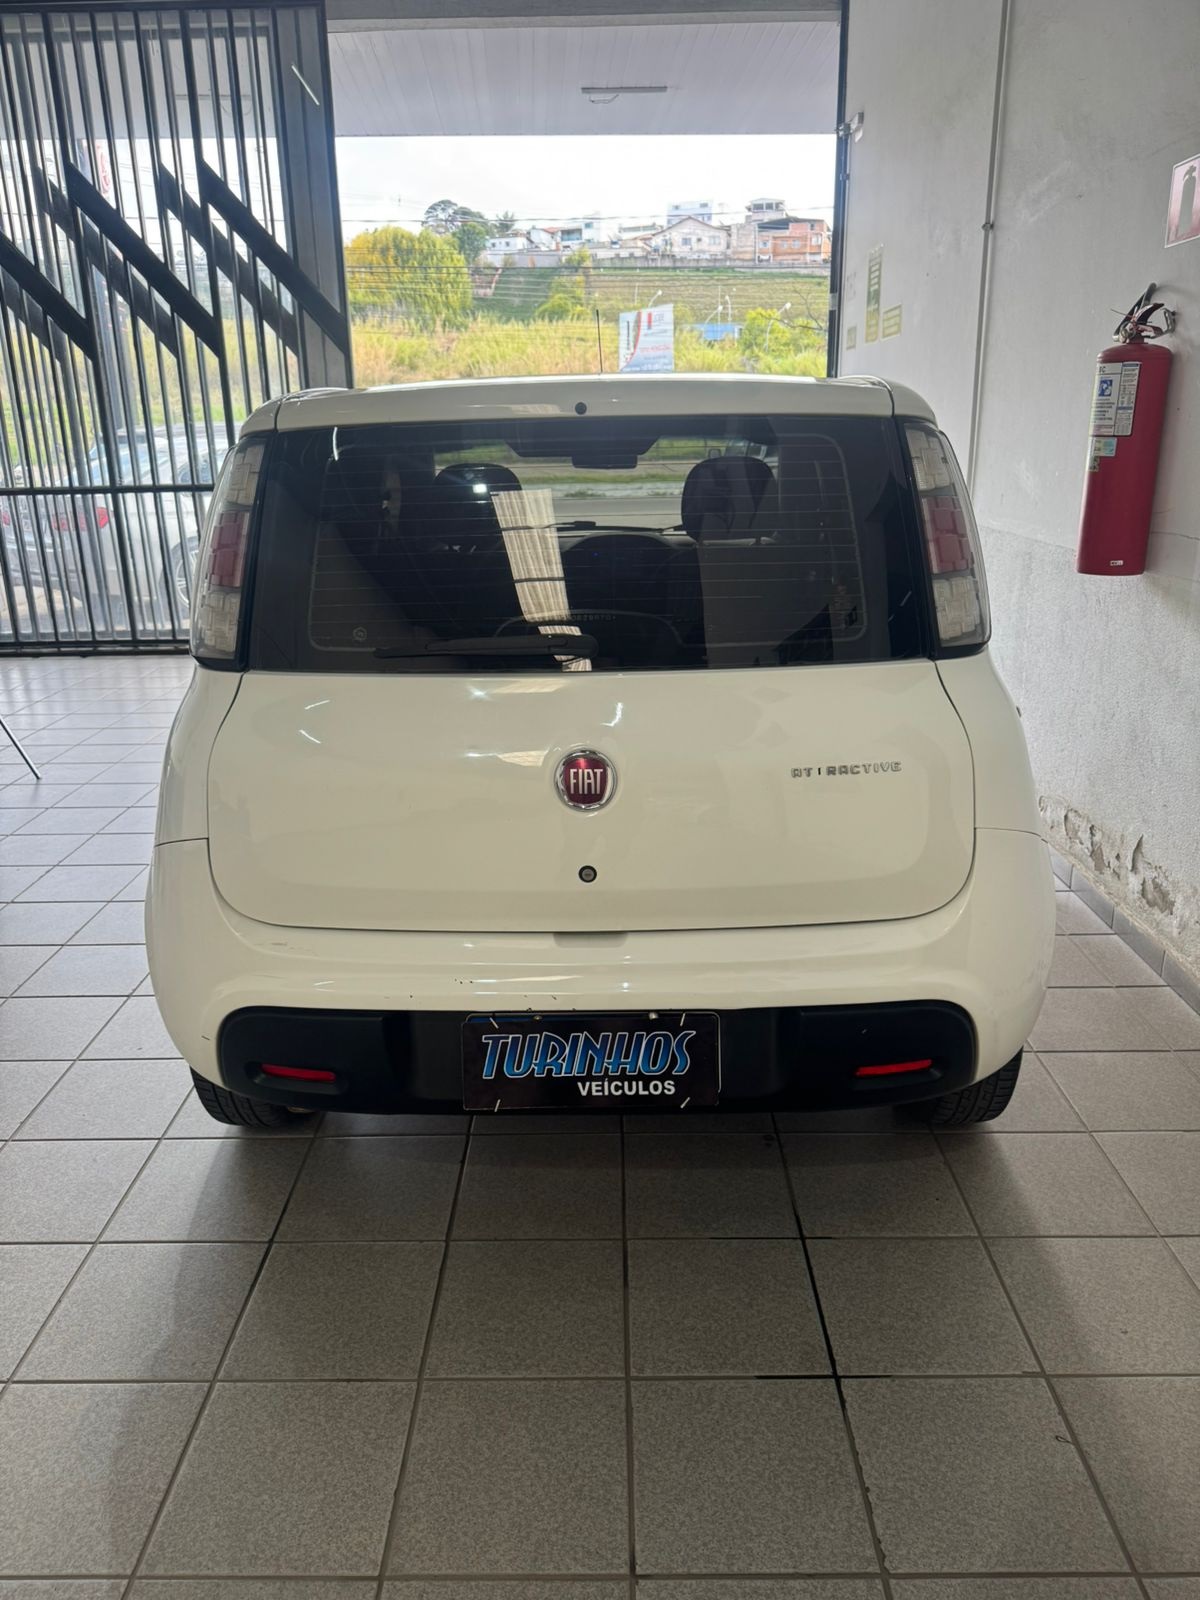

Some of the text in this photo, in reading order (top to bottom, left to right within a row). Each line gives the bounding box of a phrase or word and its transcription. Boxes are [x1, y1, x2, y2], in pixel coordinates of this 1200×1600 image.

[570, 768, 604, 795] FIAT
[482, 1031, 697, 1080] TURINHOS
[577, 1078, 676, 1097] VEÍCULOS
